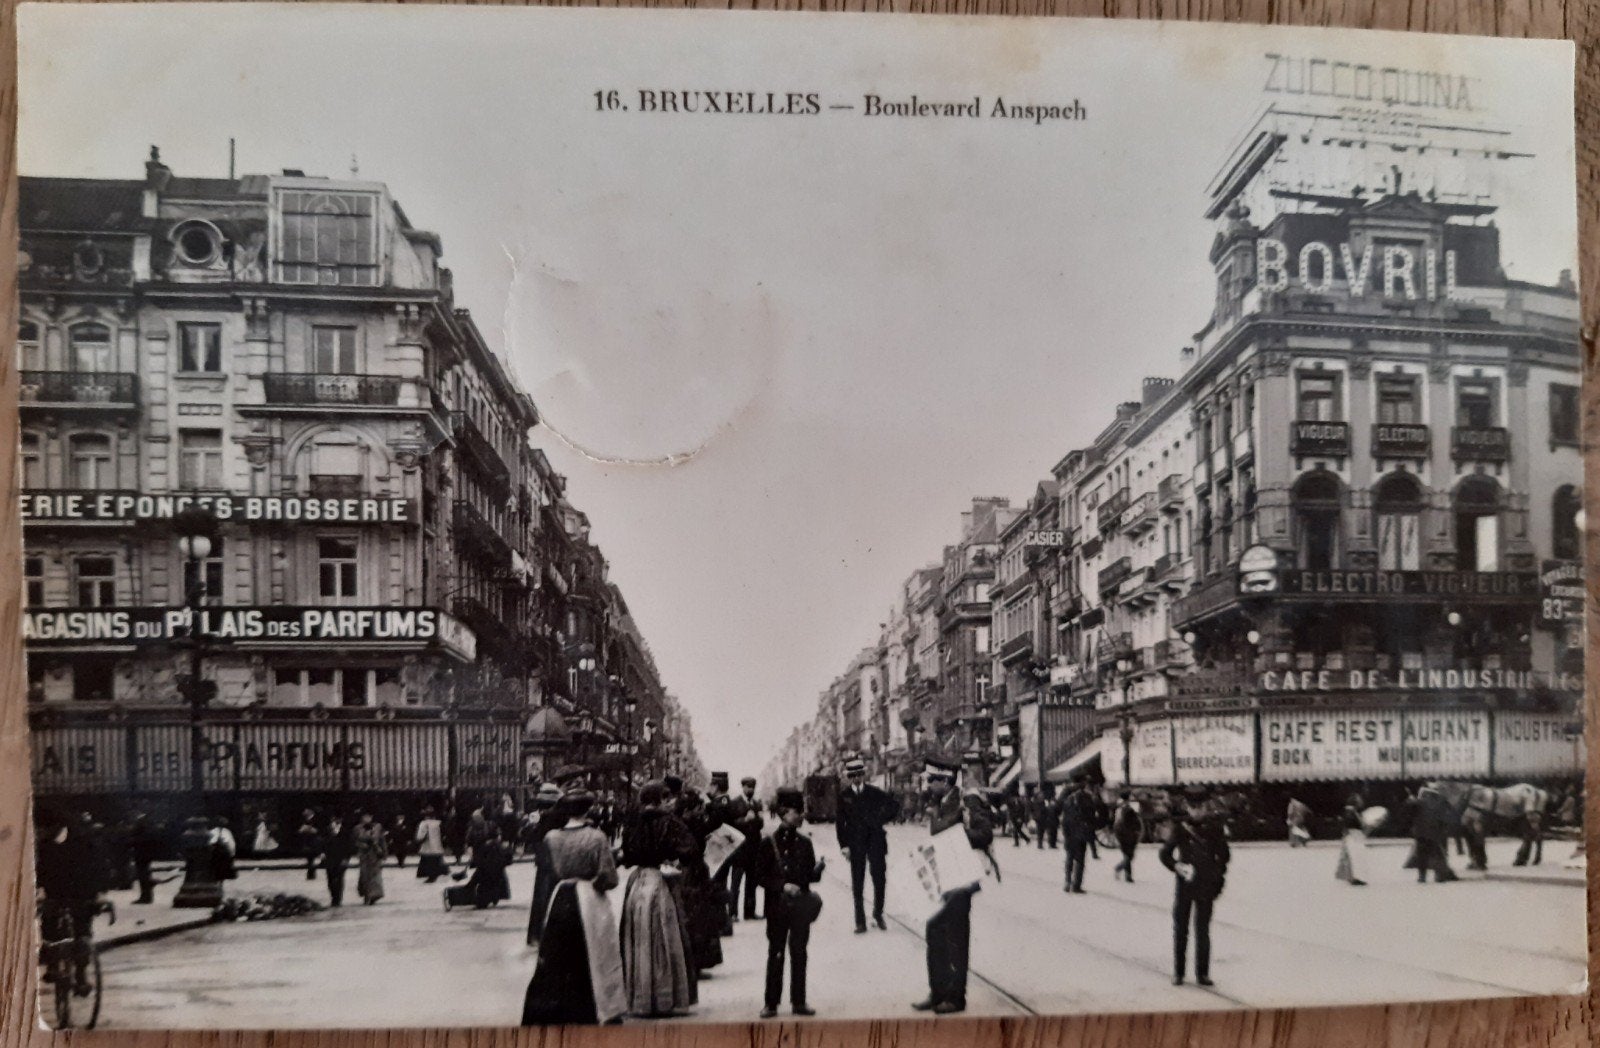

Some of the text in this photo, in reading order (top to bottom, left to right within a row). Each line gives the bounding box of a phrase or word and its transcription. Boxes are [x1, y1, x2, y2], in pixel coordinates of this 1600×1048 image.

[1256, 238, 1458, 301] BOVRIL
[1299, 424, 1345, 440] VIGUEUR
[1379, 426, 1425, 442] ELECTRO
[1301, 571, 1404, 592] ELECTRO
[1423, 572, 1520, 594] VIGUEUR
[134, 621, 162, 638] DU
[267, 621, 301, 637] DES
[303, 610, 435, 638] PARFUMS
[1263, 669, 1331, 690] CAFE
[1350, 670, 1380, 690] DE
[1268, 721, 1323, 743] CAFE
